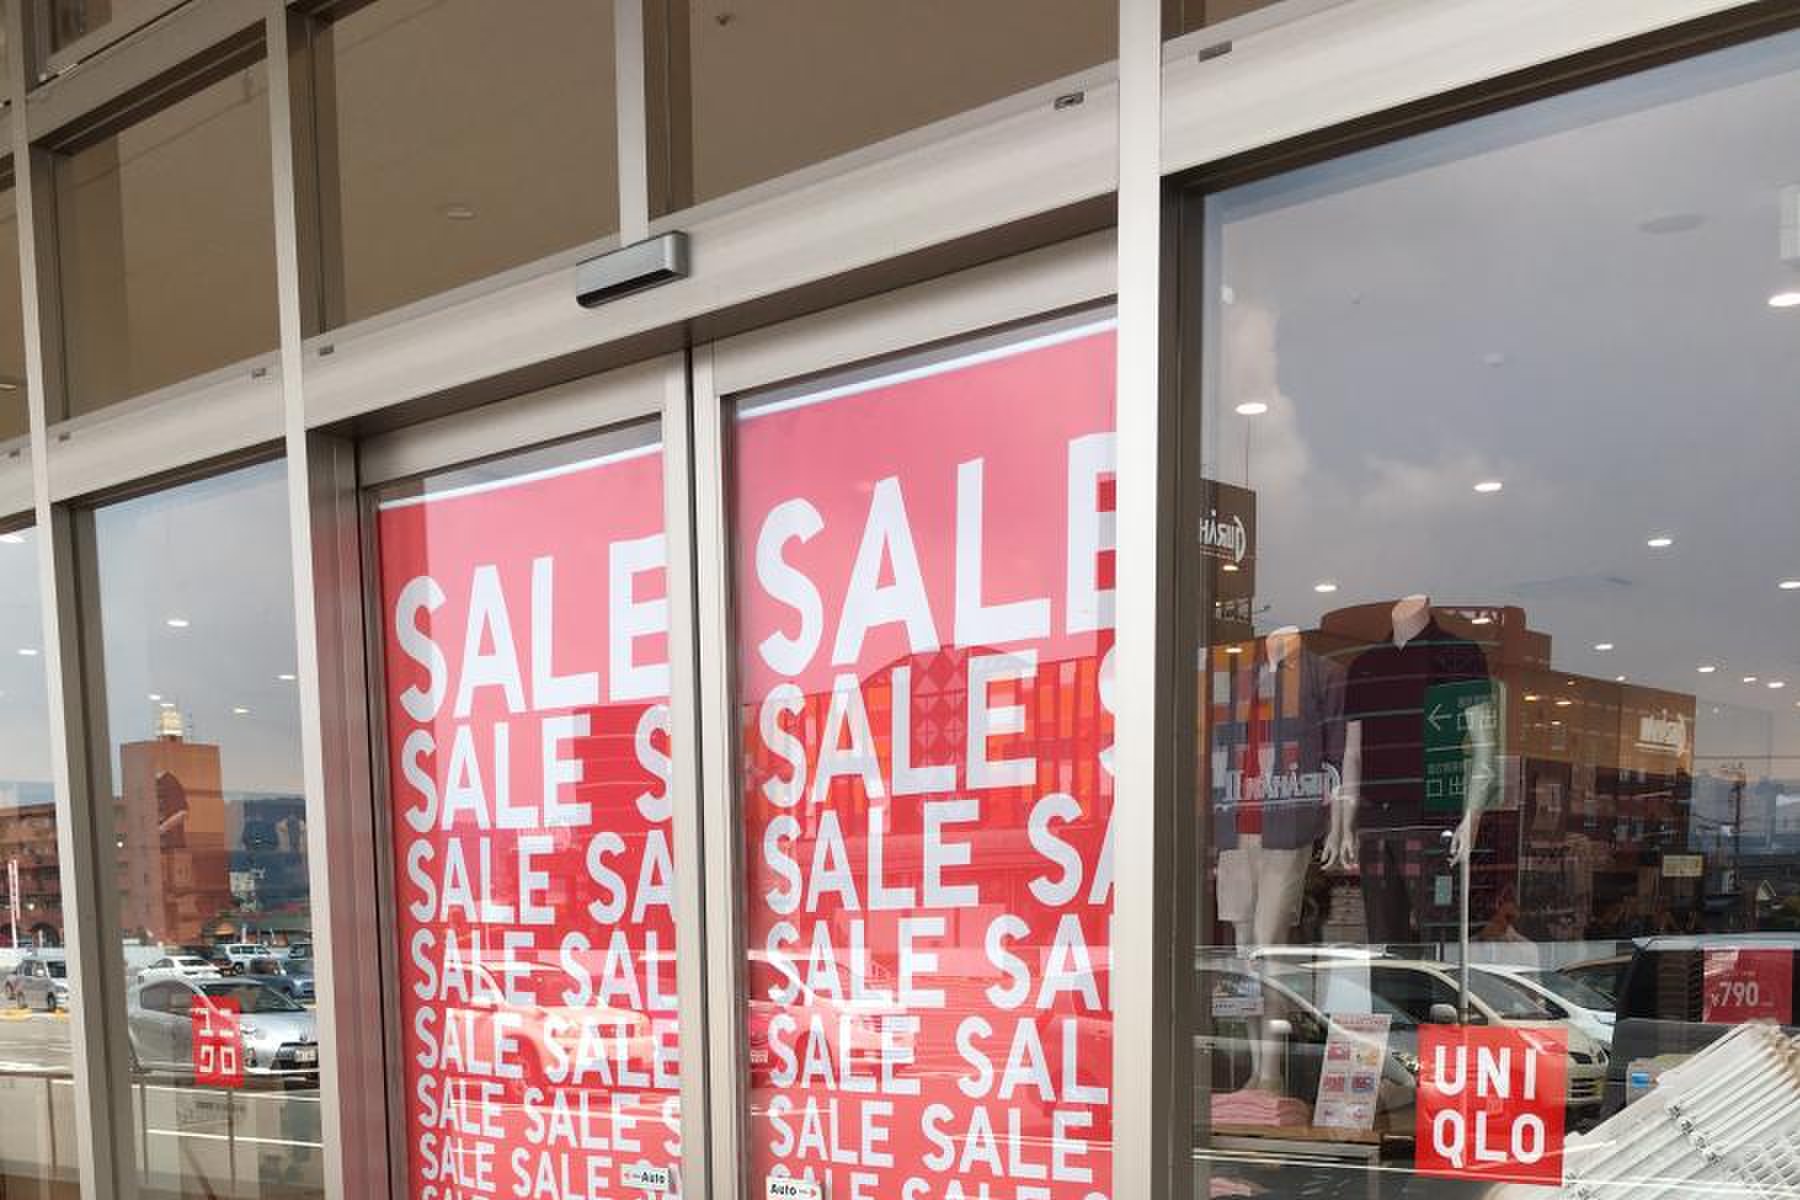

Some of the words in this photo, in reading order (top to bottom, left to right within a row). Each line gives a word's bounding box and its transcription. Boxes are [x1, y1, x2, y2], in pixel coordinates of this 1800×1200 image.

[755, 432, 1115, 676] SALE
[396, 534, 669, 723] SALE
[759, 648, 1038, 807] SALE
[402, 714, 592, 832] SALE
[406, 836, 556, 924] SALE
[587, 830, 676, 924] SA
[763, 800, 979, 914] SALE
[411, 928, 536, 1008] SALE
[561, 930, 678, 1011] SAL
[767, 918, 946, 1010] SALE
[415, 1006, 523, 1079] SALE
[543, 1012, 680, 1089] SALE
[768, 1012, 920, 1096] SALE
[956, 1016, 1108, 1105] SAL
[1434, 1045, 1537, 1100] UNI
[417, 1075, 506, 1138] SALE
[523, 1087, 641, 1152] SALE
[769, 1095, 894, 1168] SALE
[921, 1103, 1093, 1184] SALE
[1432, 1108, 1546, 1169] QLO
[420, 1133, 496, 1193] SALE
[641, 1171, 665, 1184] Auto
[769, 1183, 798, 1196] Auto
